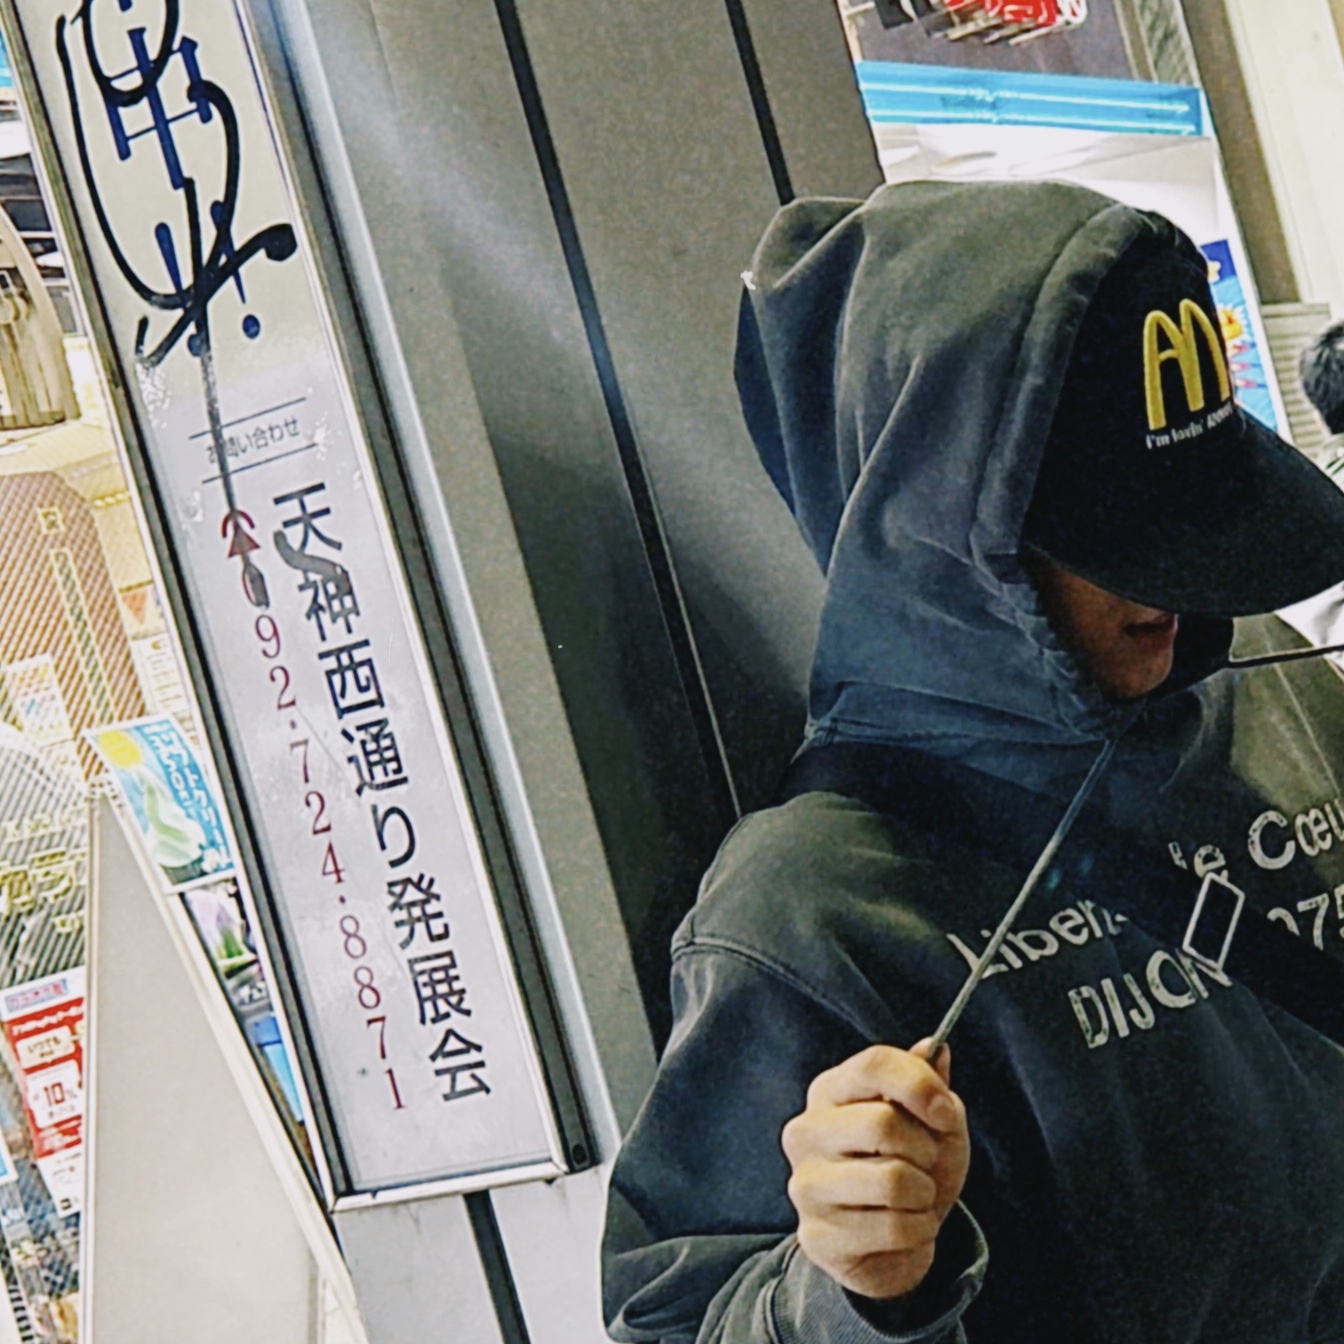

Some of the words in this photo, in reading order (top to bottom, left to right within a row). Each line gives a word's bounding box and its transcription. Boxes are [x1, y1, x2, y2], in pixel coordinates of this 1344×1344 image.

[273, 481, 492, 1103] 天神西通り発展会
[946, 899, 1130, 981] Liber
